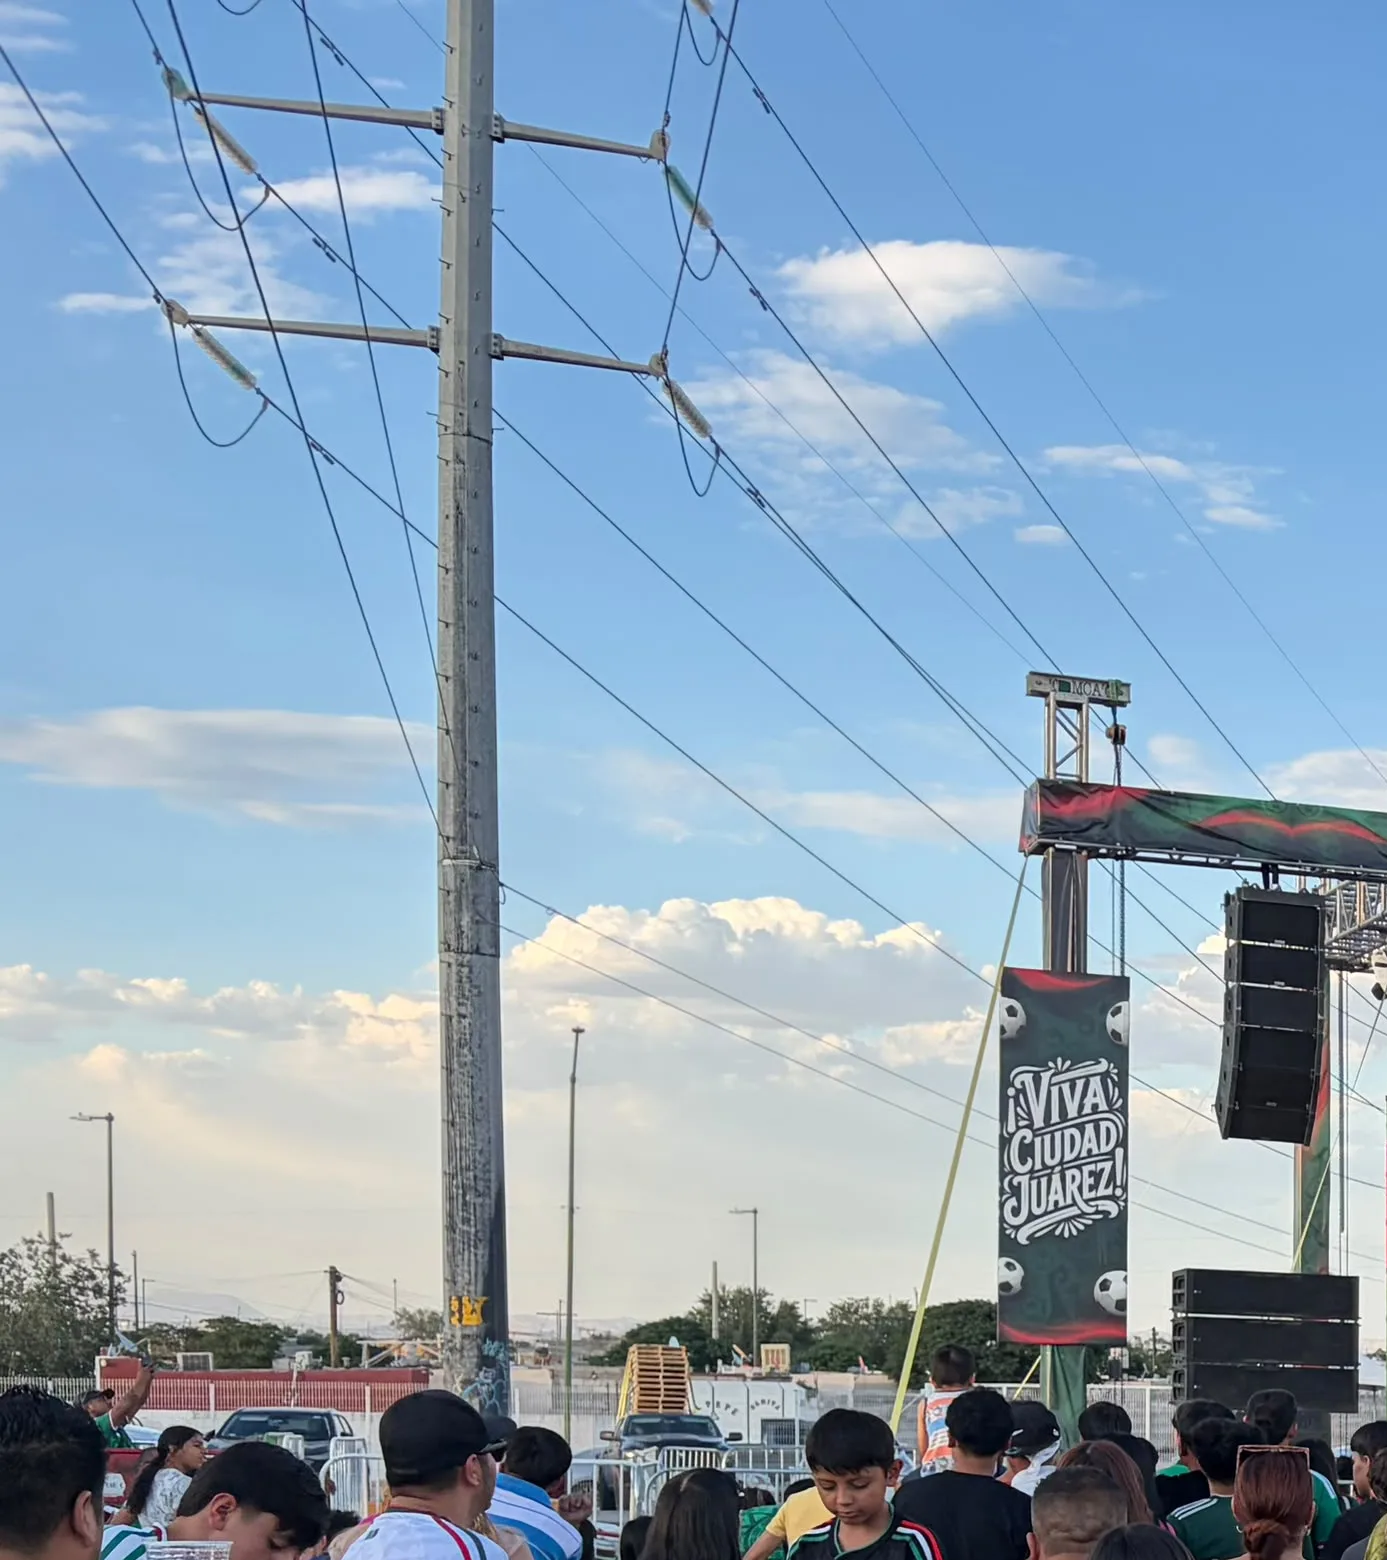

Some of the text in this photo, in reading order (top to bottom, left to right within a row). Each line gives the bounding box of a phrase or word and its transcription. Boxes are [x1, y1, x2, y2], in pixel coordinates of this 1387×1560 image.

[1007, 1069, 1110, 1134] ¡VIVA
[1010, 1120, 1118, 1174] CIUDAD
[1003, 1148, 1124, 1226] JUÁREZ!
